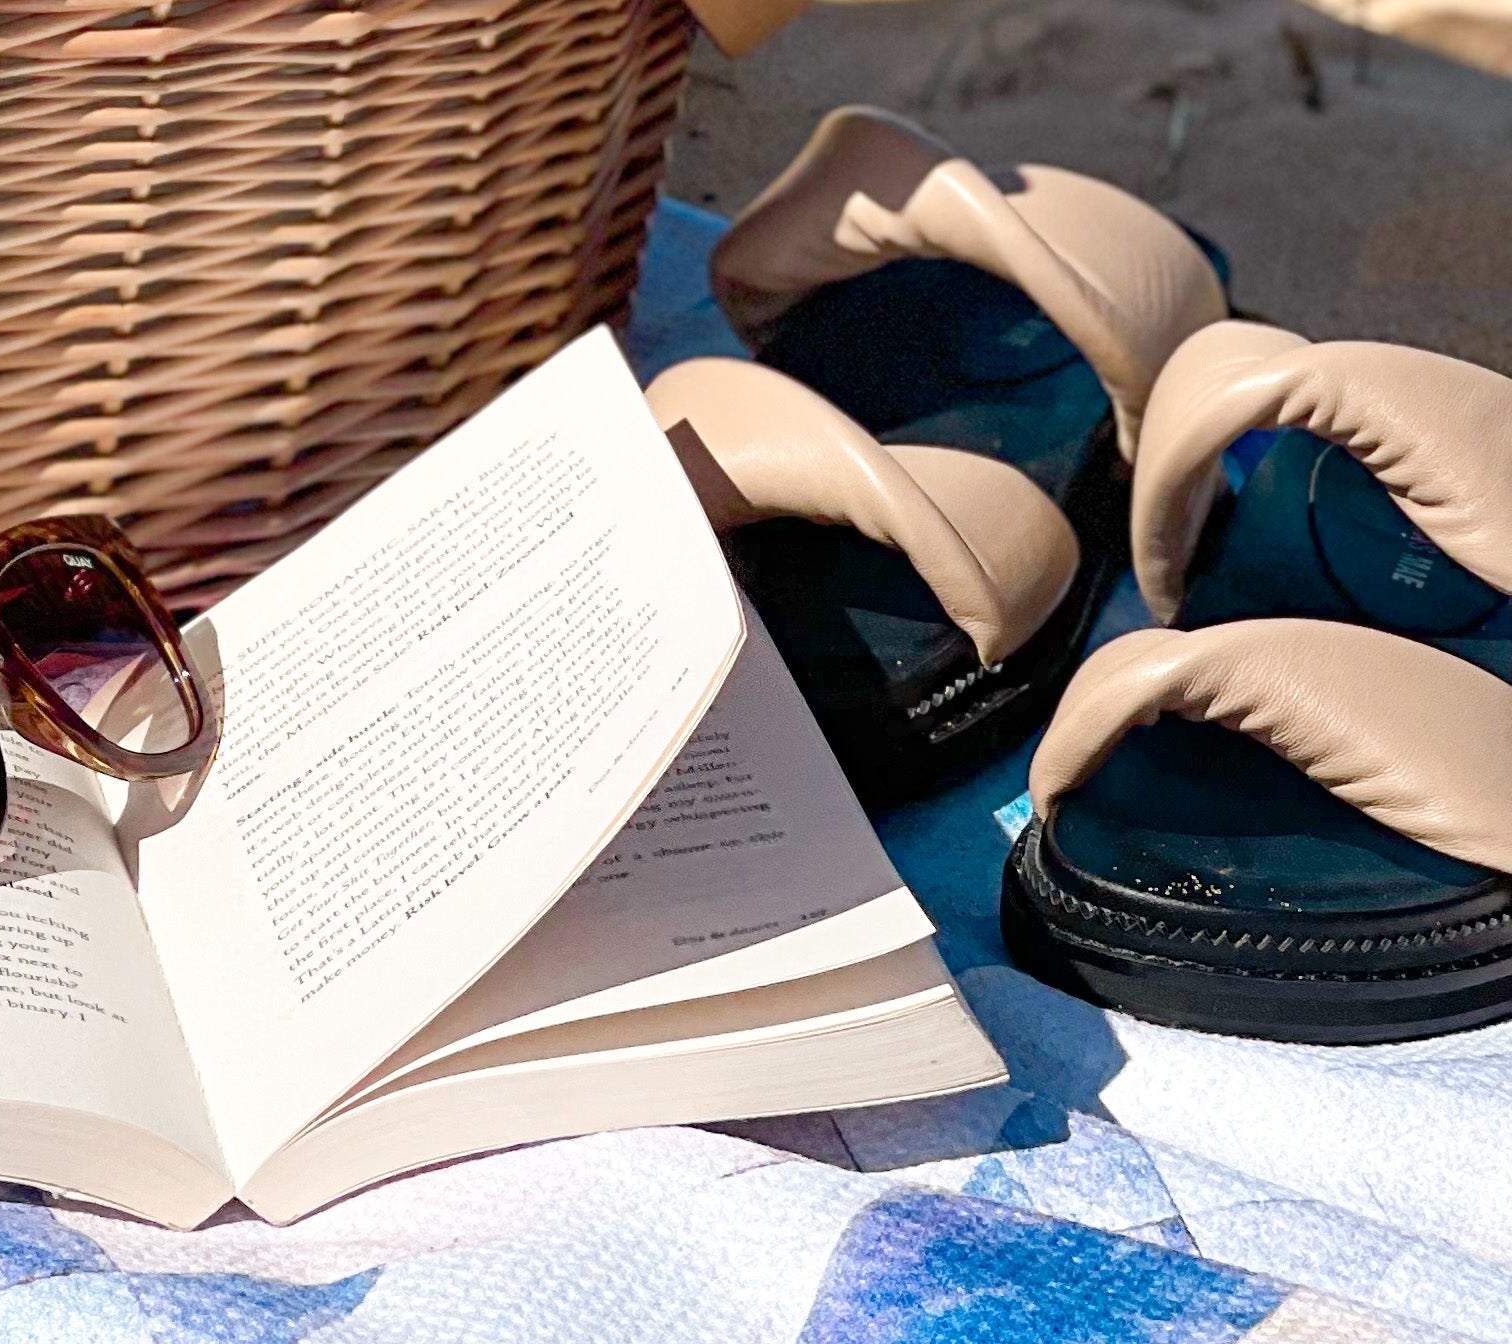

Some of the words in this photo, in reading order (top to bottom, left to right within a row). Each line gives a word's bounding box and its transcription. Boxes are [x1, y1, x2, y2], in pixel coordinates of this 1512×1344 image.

[416, 612, 452, 642] Risk
[495, 537, 545, 580] Zeroes
[548, 510, 574, 538] and
[235, 775, 302, 827] Starting
[315, 743, 345, 768] side
[346, 702, 399, 744] hustle:
[403, 659, 455, 699] Totally
[277, 917, 303, 941] Get
[305, 890, 338, 917] Your
[341, 867, 369, 892] Shit
[371, 819, 434, 866] Together,
[436, 795, 464, 817] but
[467, 782, 479, 793] it
[482, 740, 527, 780] comes
[531, 684, 586, 739] AFTER
[288, 949, 314, 971] the
[318, 921, 350, 949] first
[354, 887, 397, 925] place,
[411, 852, 439, 875] can
[442, 826, 467, 851] tell
[469, 802, 498, 828] you
[501, 771, 532, 801] that
[300, 967, 342, 1004] make
[404, 888, 442, 920] Risk
[441, 851, 484, 892] level:
[486, 808, 530, 849] Grow
[7, 940, 50, 954] your
[18, 957, 59, 971] next
[65, 966, 84, 977] to
[26, 912, 90, 942] itching
[51, 936, 75, 948] up
[30, 985, 63, 1002] but
[67, 994, 107, 1015] look
[112, 1012, 129, 1024] at
